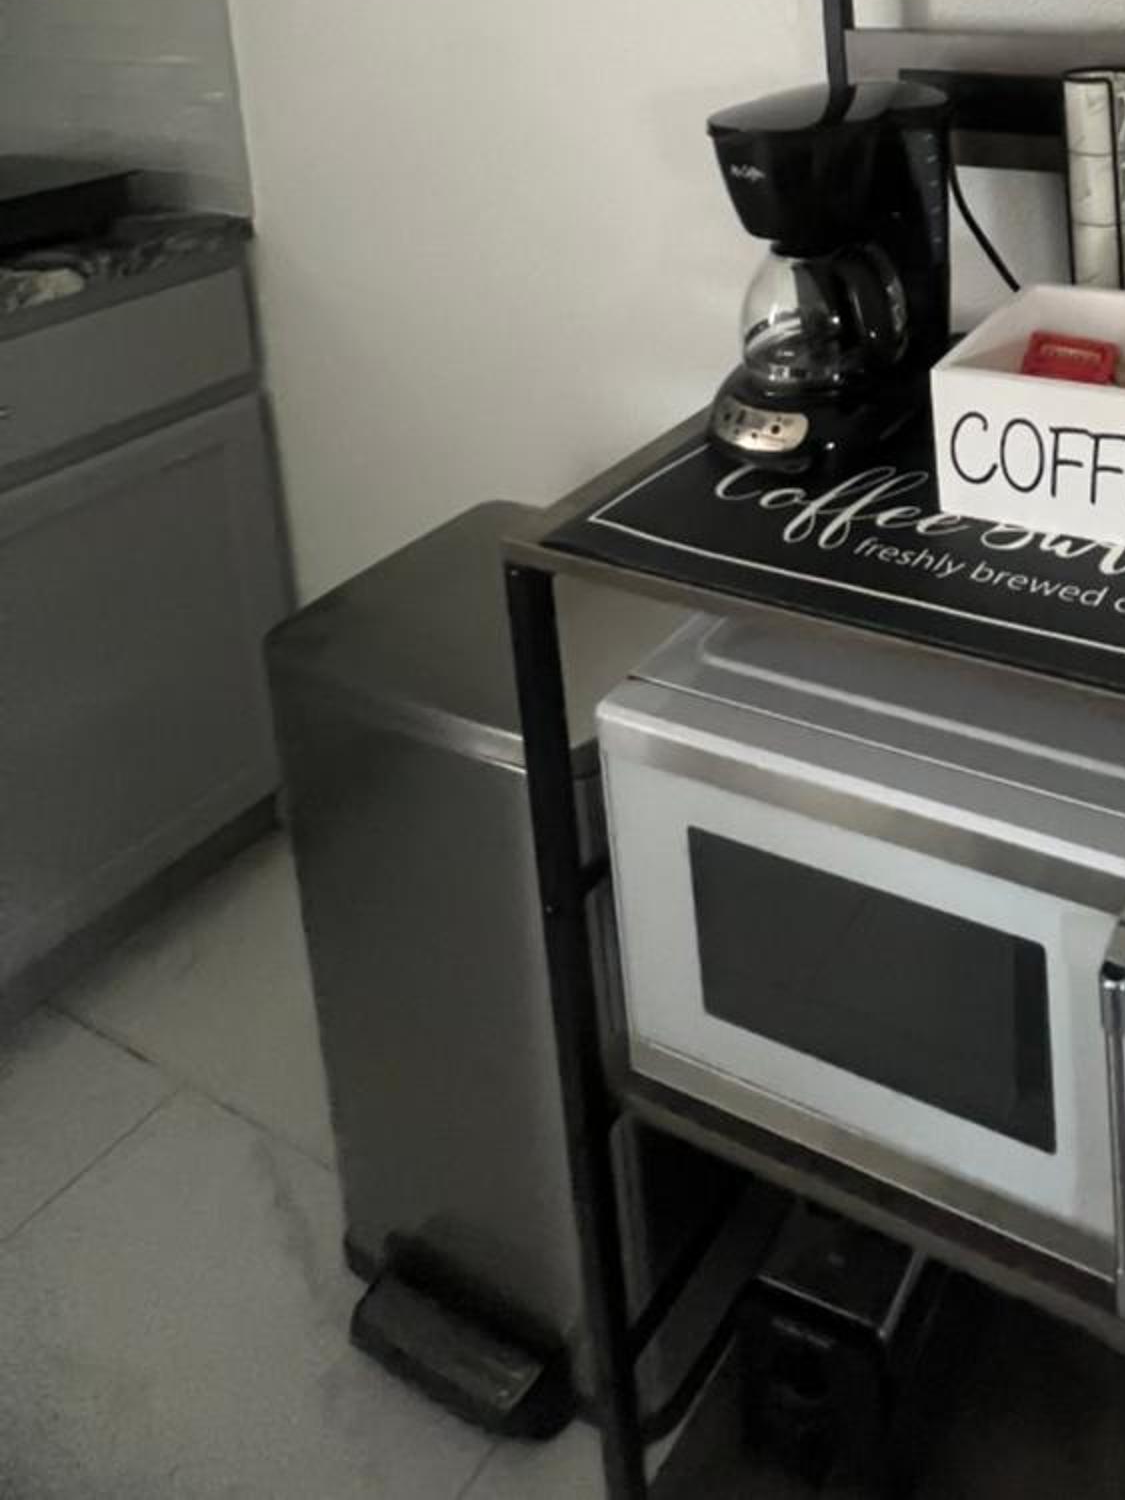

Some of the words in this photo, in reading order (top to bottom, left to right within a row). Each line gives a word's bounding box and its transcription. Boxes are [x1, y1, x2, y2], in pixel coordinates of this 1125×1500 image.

[714, 462, 971, 549] Coffee
[853, 536, 966, 580] freshly
[969, 561, 1111, 607] brewed
